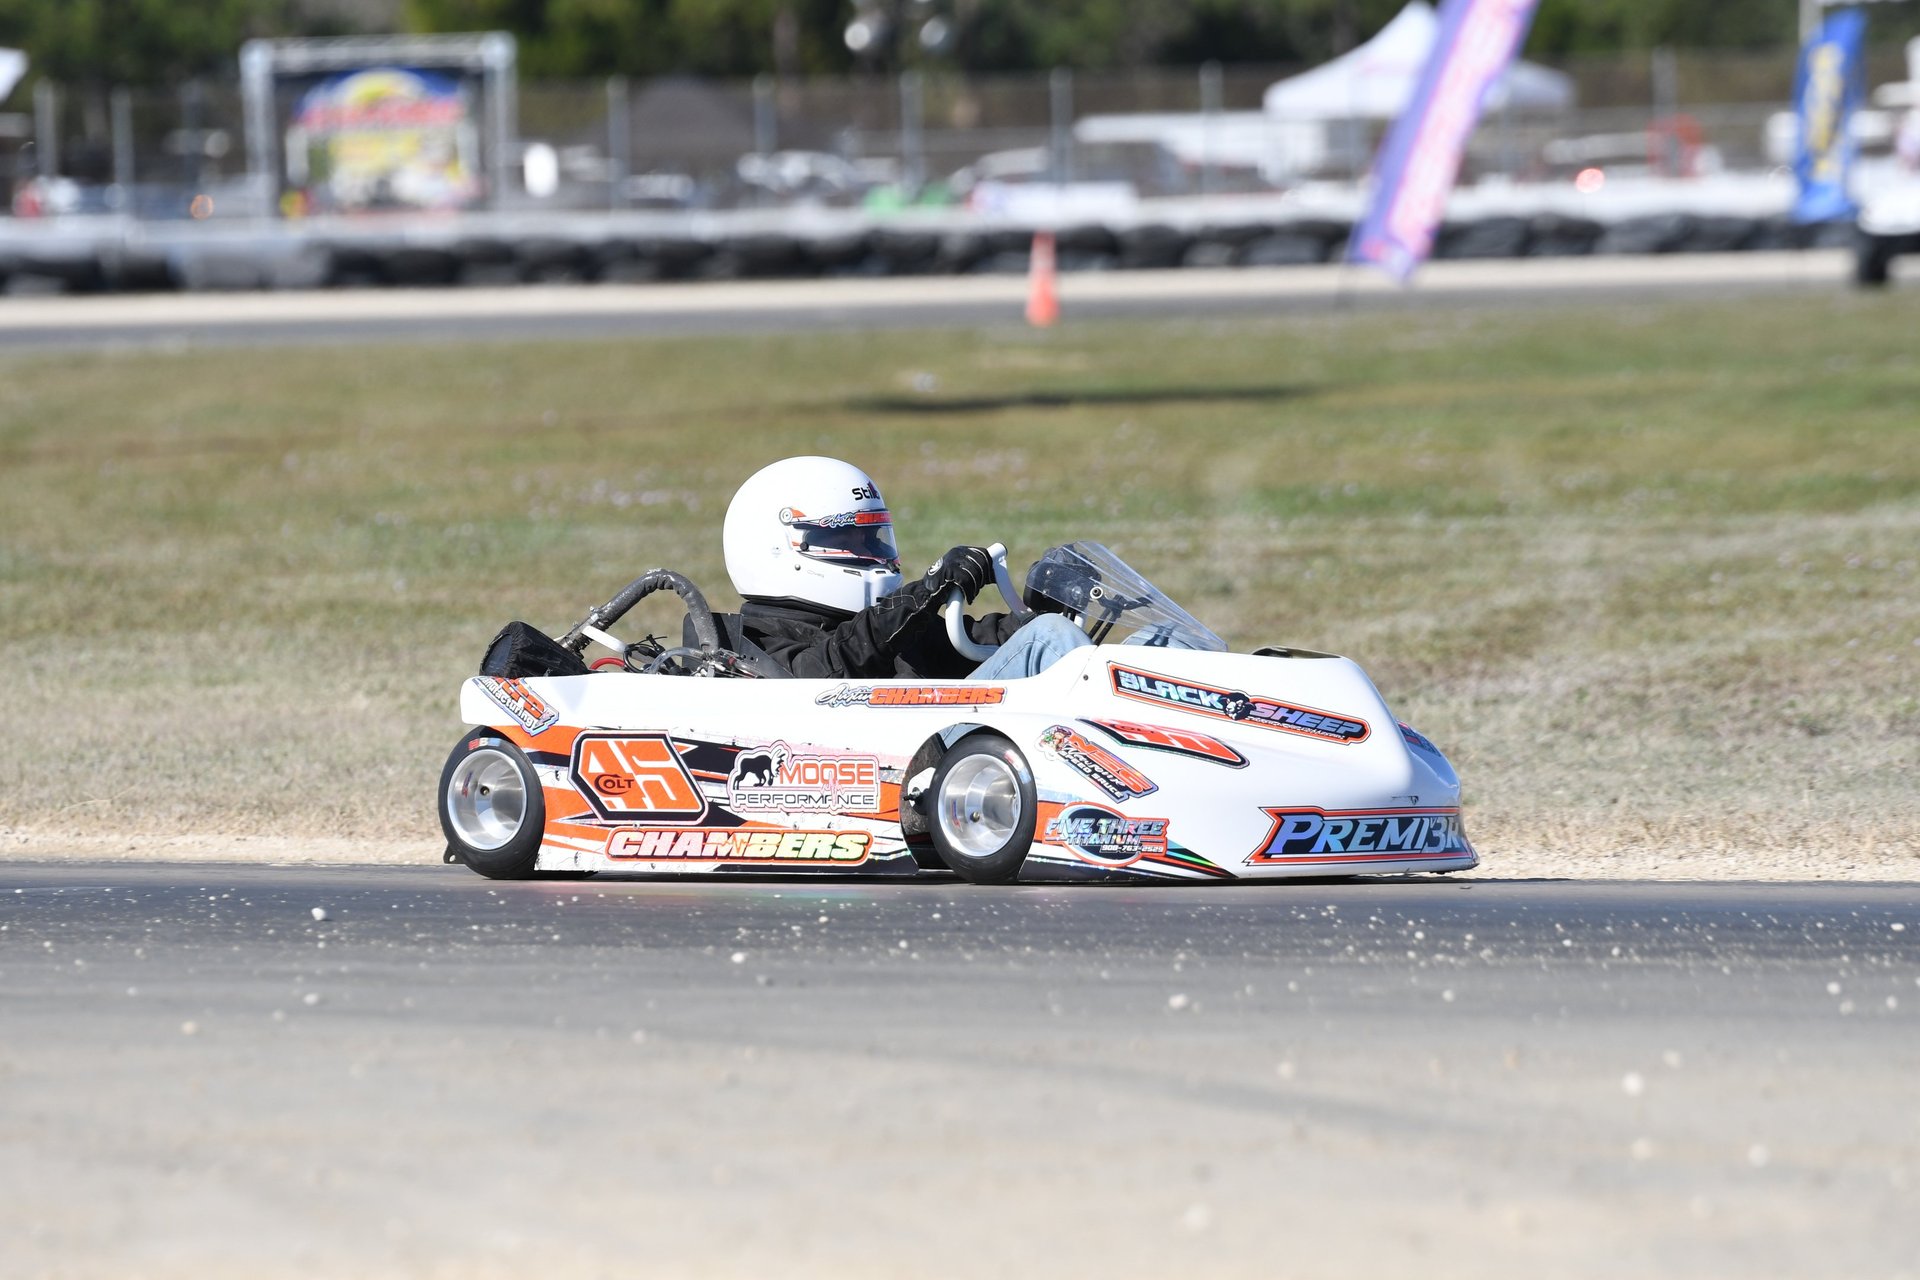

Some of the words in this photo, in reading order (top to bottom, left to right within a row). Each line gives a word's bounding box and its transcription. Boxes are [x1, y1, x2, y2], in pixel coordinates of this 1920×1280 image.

[815, 683, 873, 705] Austin
[869, 687, 1005, 705] CHAMBERS
[1118, 670, 1224, 709] BLACK
[1250, 702, 1364, 735] SHEEP
[579, 740, 701, 810] 45
[594, 773, 636, 796] COLT
[780, 763, 874, 784] MOOSE
[1057, 750, 1093, 775] SPEED
[1090, 772, 1123, 799] SAUCE
[735, 794, 875, 805] PERFORMANCE
[1045, 818, 1096, 834] FIVE
[1097, 818, 1166, 836] THREE
[607, 830, 870, 859] CHAMBERS
[1066, 833, 1140, 846] TITANIUM
